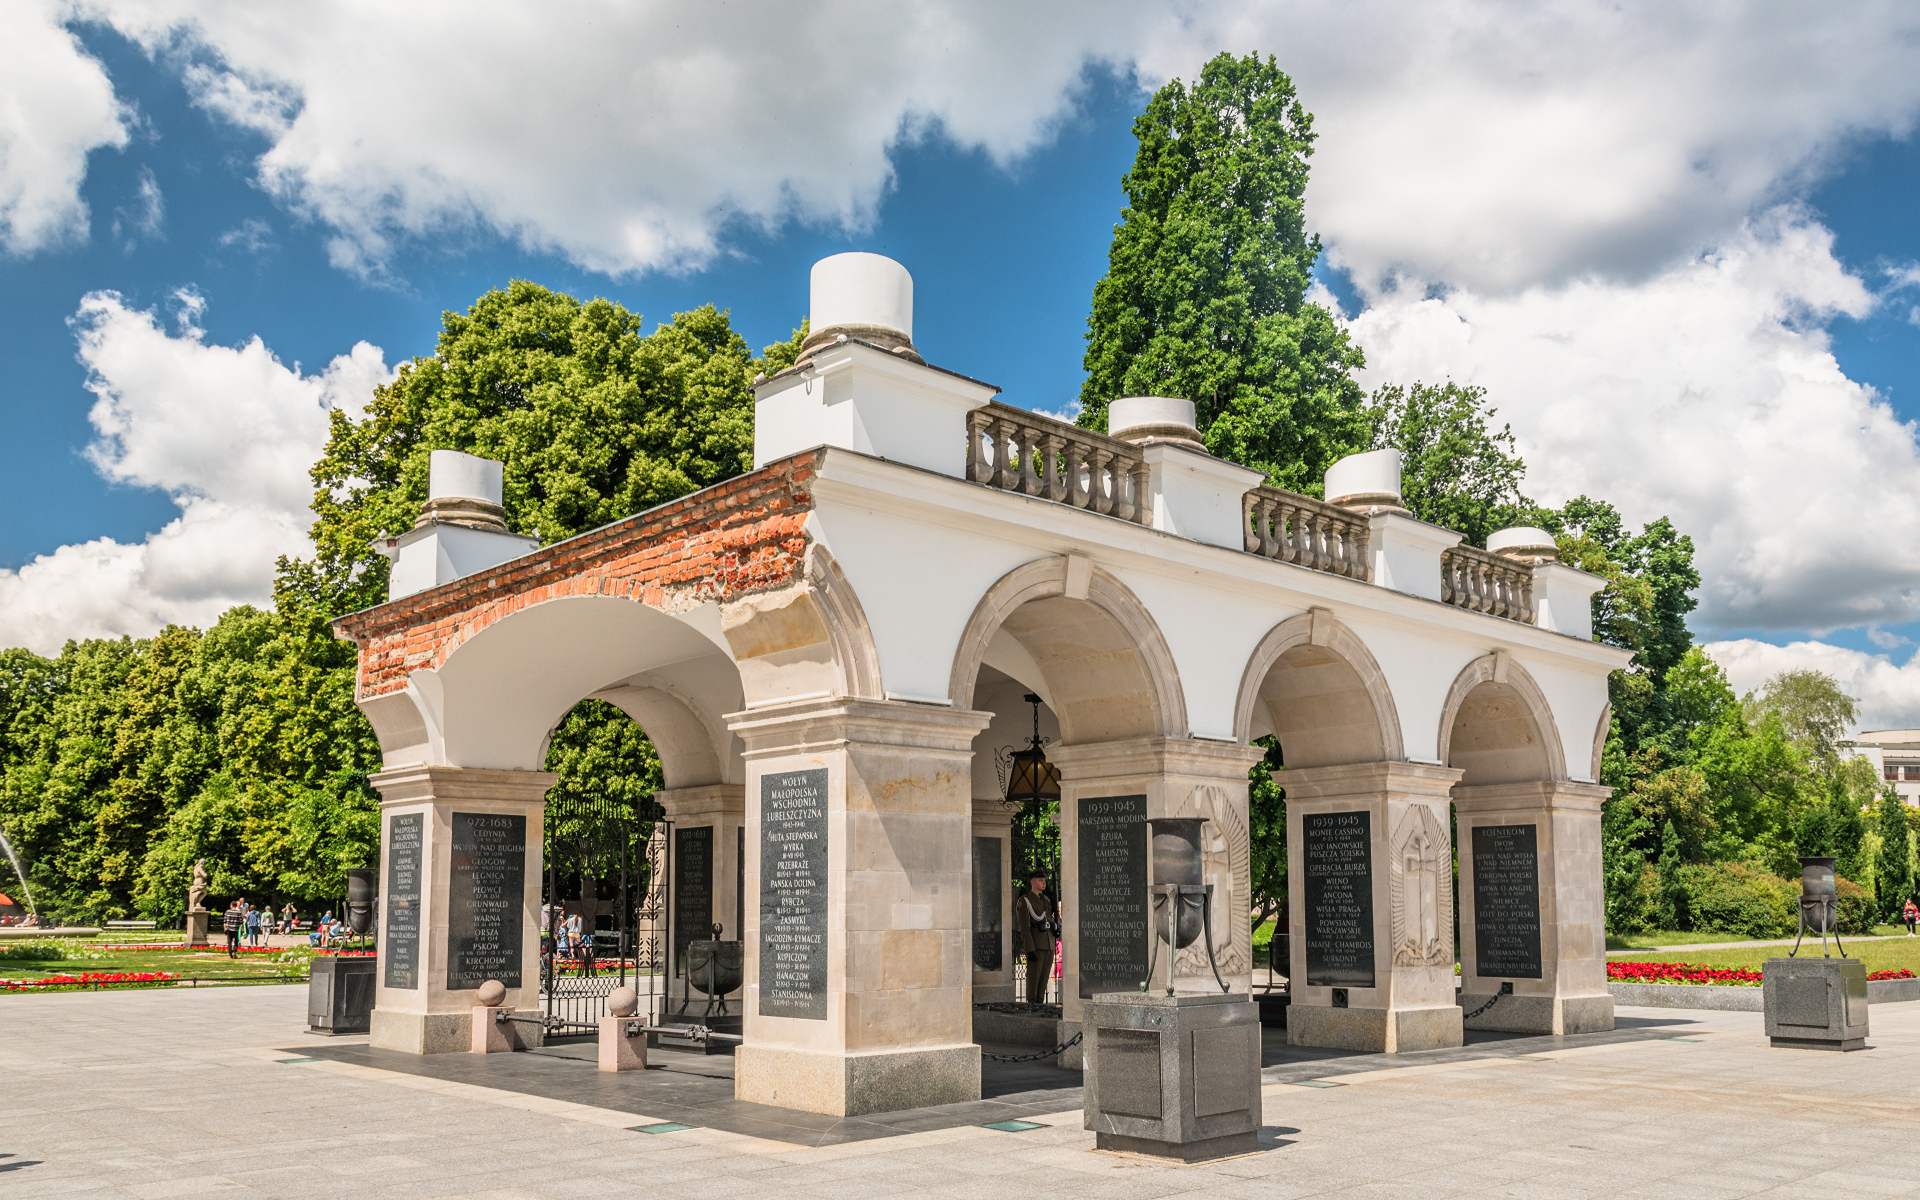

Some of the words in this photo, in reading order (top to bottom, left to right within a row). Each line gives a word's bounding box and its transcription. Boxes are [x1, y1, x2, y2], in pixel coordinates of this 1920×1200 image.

[772, 787, 817, 800] MAŁOPOLSKA
[773, 798, 816, 809] WSCHODNIA
[1089, 801, 1135, 814] 1939-1945
[767, 809, 822, 821] LUBELSZCZYZNA
[467, 818, 512, 828] 972-1683
[1102, 832, 1122, 840] BZURA
[1334, 827, 1364, 836] CASSINO
[1483, 828, 1525, 836] LOTNIKOM
[794, 879, 816, 888] DOLINA
[1094, 888, 1131, 896] BORATYCZE
[782, 898, 804, 906] RYBCZA
[1128, 904, 1140, 913] LUB
[781, 916, 806, 924] ZASMYKI
[1082, 921, 1111, 929] OBRONA
[1114, 921, 1146, 929] GRANICY
[1133, 930, 1142, 938] RP
[1097, 946, 1129, 955] GRODNO
